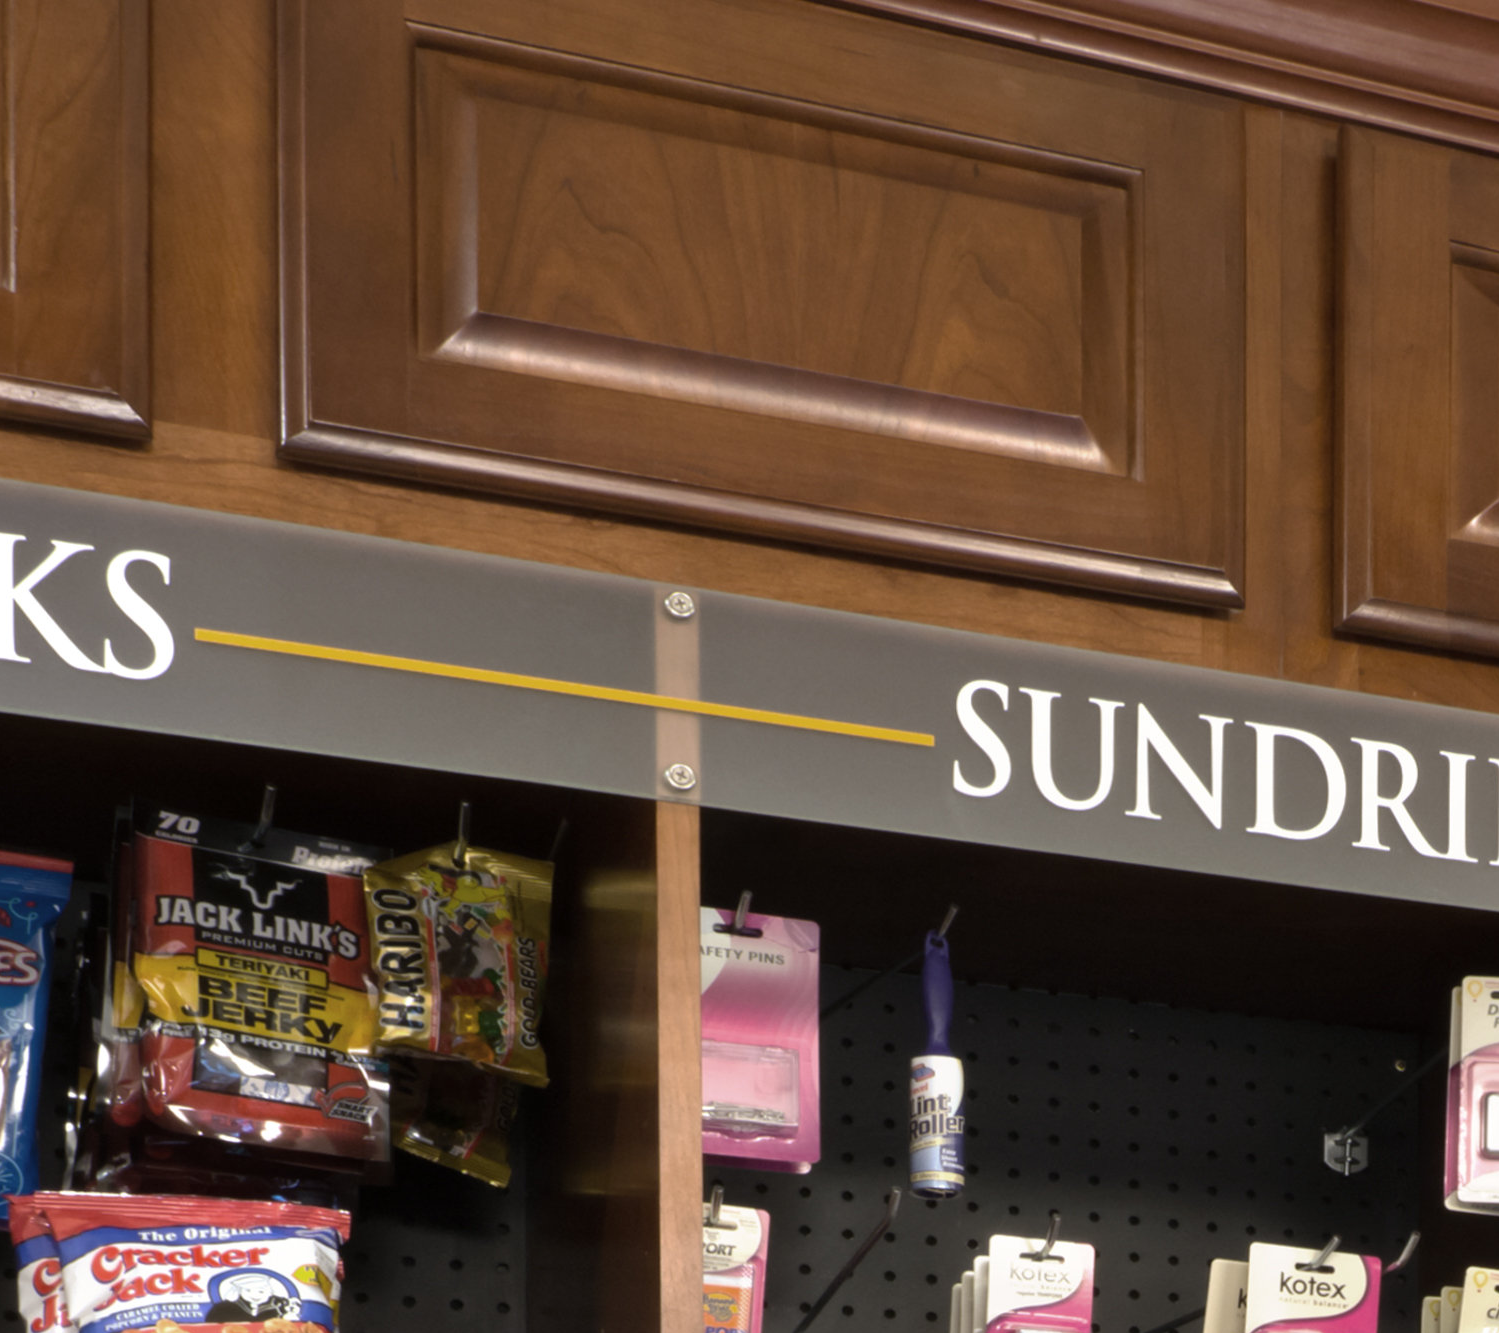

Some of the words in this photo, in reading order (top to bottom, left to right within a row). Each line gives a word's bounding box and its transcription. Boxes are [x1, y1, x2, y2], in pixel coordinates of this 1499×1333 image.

[155, 896, 242, 931] JACK
[252, 911, 359, 960] LINK'S
[201, 930, 278, 953] PREMIUM
[280, 946, 324, 962] CUTS
[215, 952, 310, 982] TERIYAKI
[372, 888, 425, 1031] HARIBO
[748, 951, 786, 967] PINS
[198, 975, 329, 1016] BEEF
[519, 936, 538, 1050] GOLD-BEARS
[182, 996, 343, 1044] JERKY
[909, 1114, 965, 1139] Roller
[137, 1229, 178, 1242] The
[183, 1225, 272, 1242] Original
[90, 1244, 271, 1285] Cracker
[93, 1268, 205, 1312] Jack
